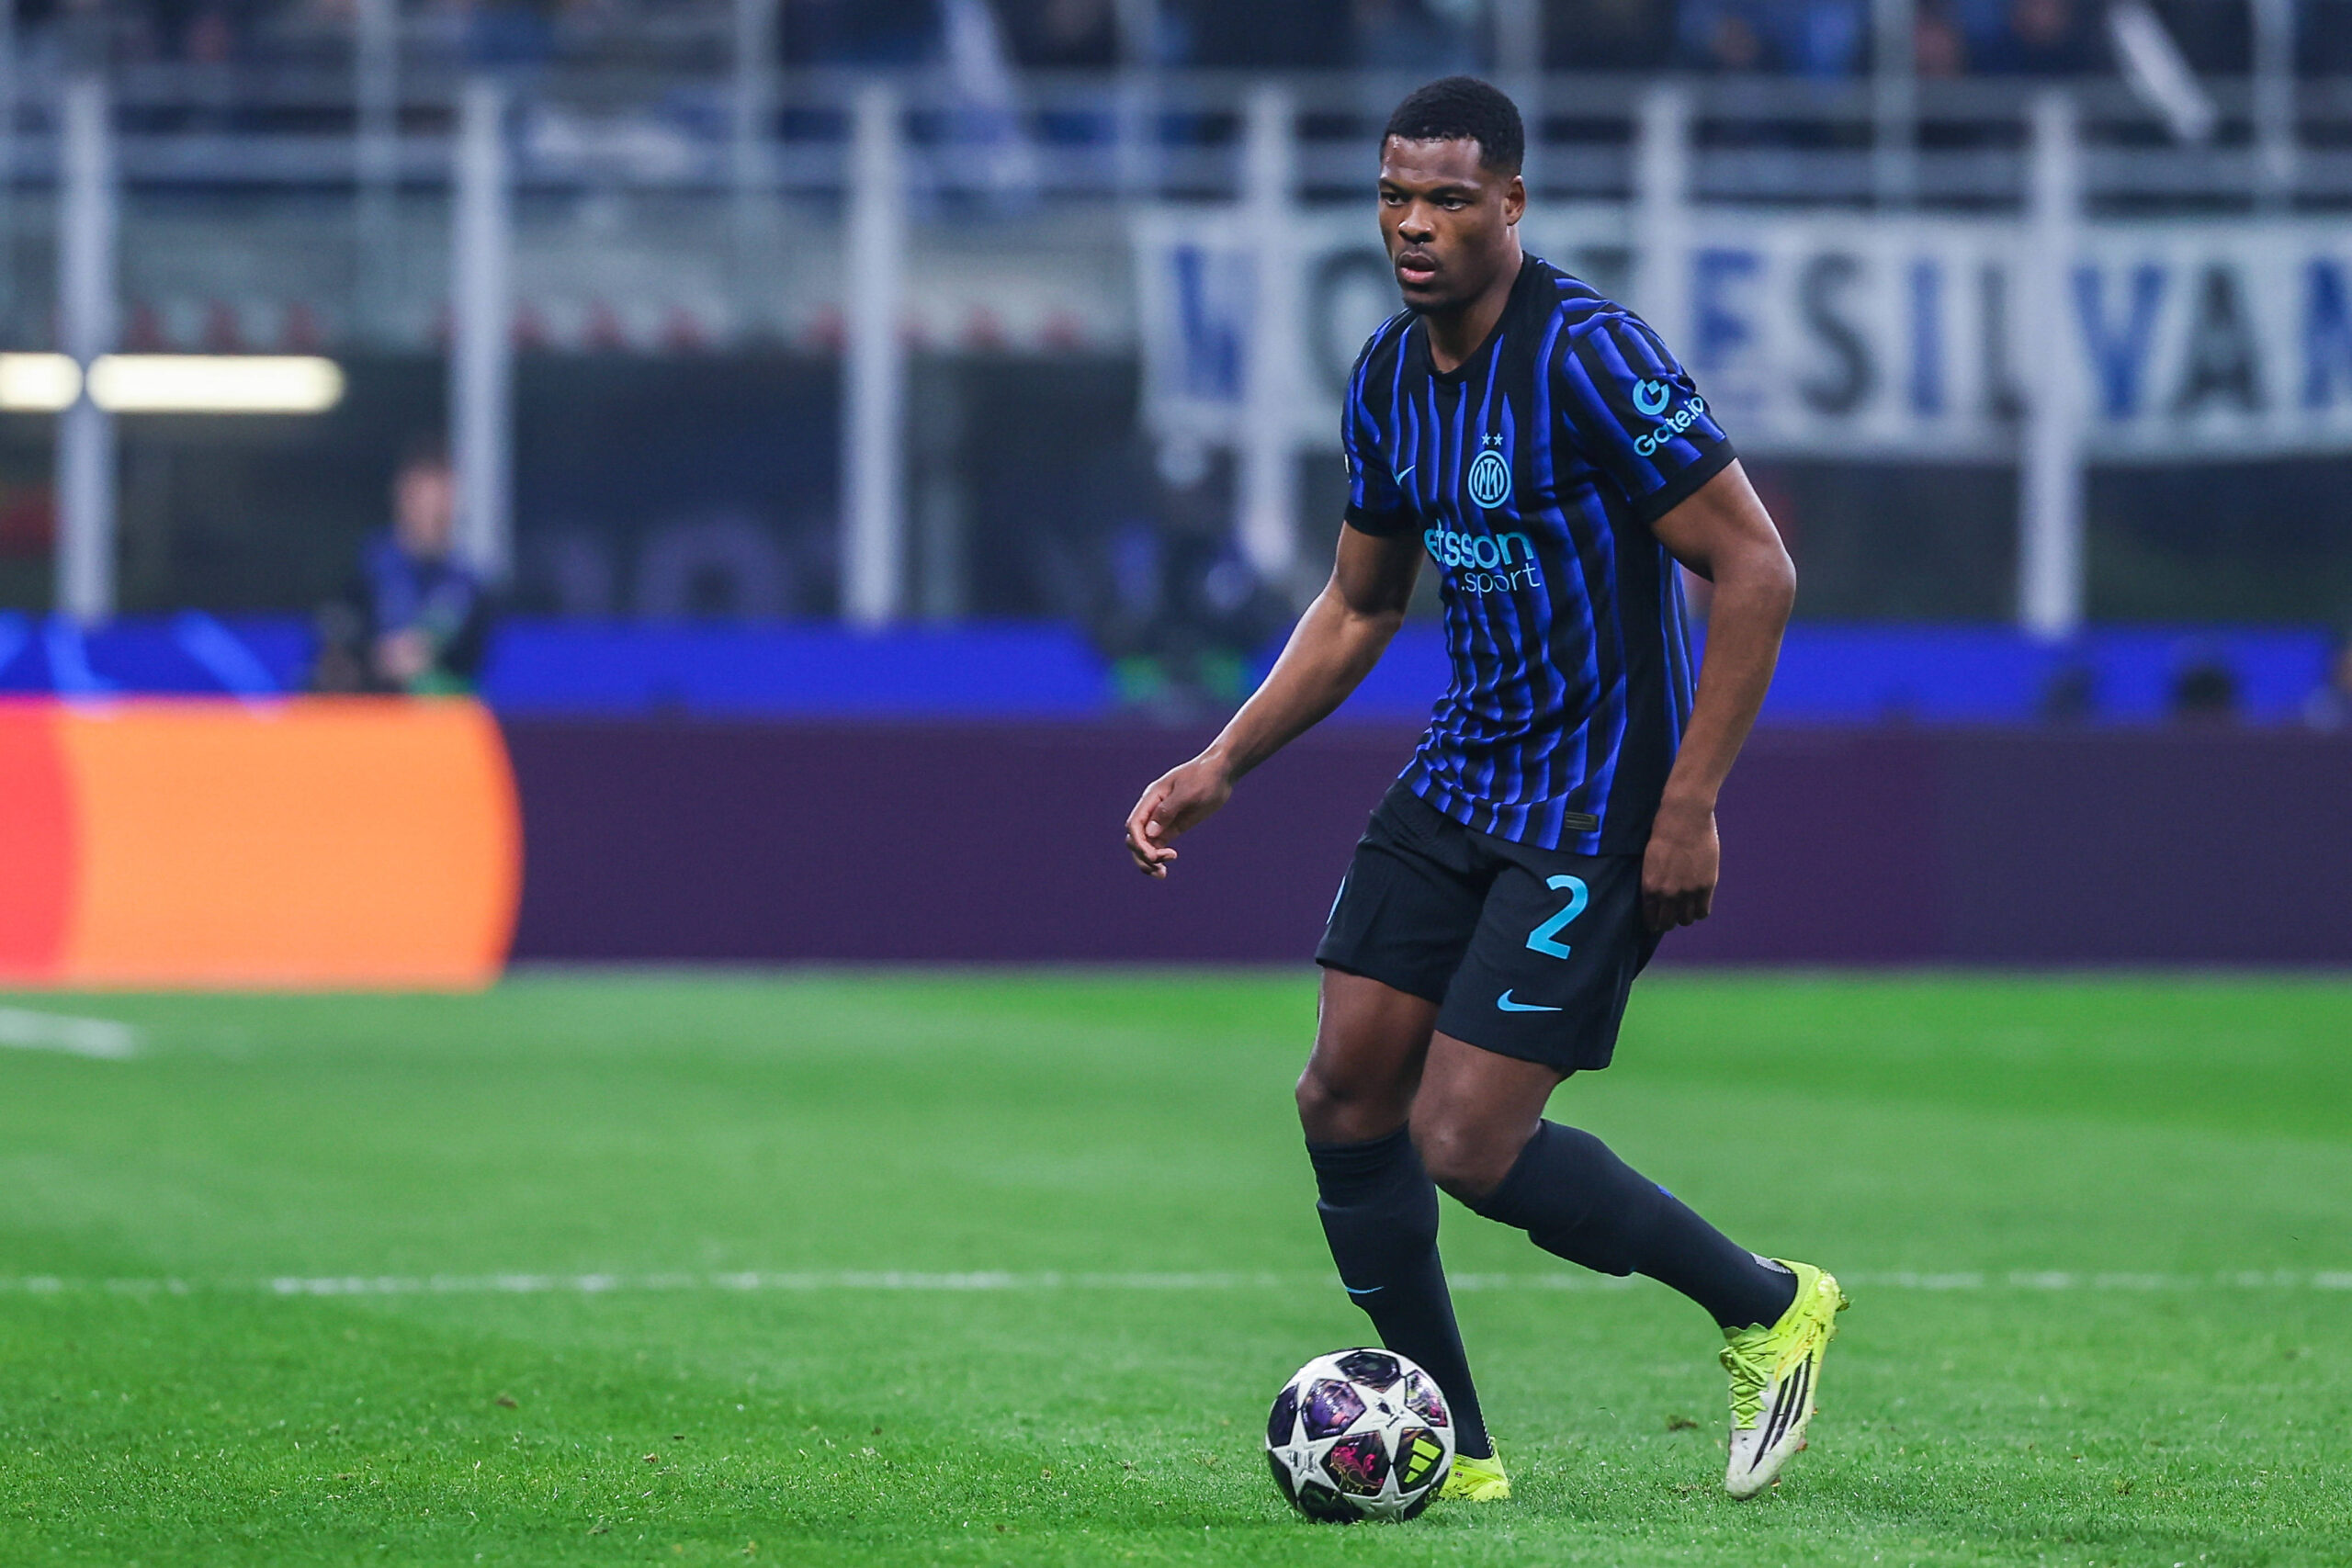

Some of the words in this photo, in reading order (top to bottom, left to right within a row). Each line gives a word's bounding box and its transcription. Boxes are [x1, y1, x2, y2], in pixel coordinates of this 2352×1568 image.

[1634, 397, 1705, 457] Gate.io
[1424, 518, 1534, 569] etsson
[1525, 874, 1589, 960] 2
